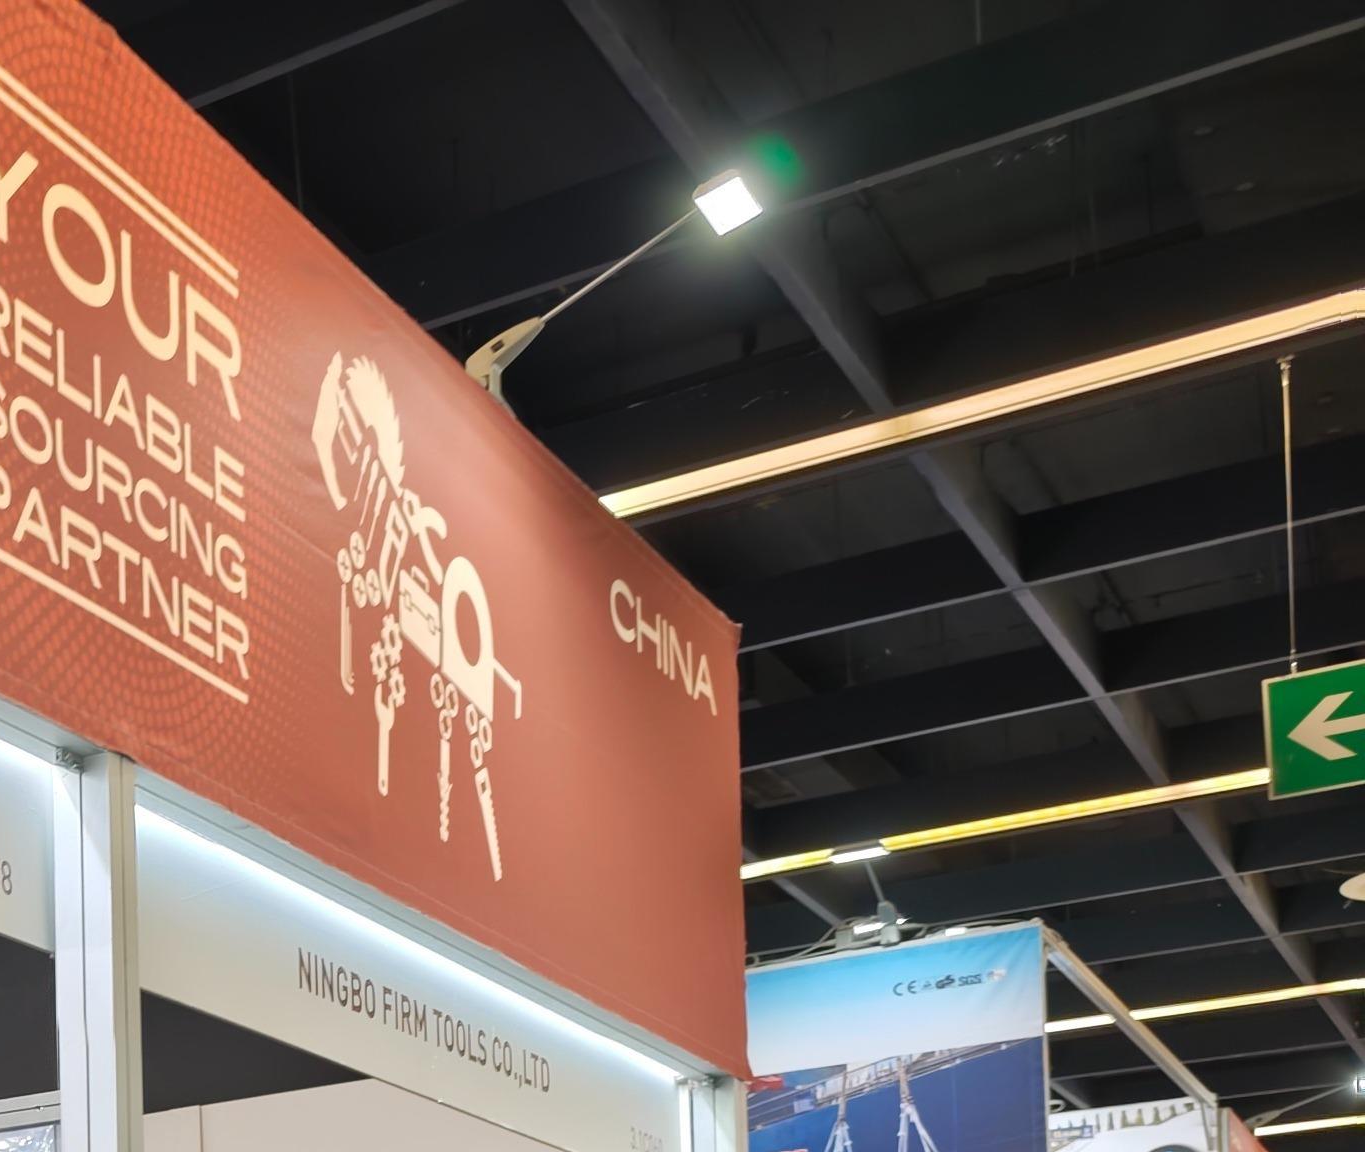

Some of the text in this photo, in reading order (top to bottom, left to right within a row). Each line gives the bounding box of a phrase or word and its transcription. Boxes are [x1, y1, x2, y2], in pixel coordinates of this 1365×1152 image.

[610, 578, 718, 717] CHINA
[297, 947, 550, 1093] NINGBO FIRM TOOLS CO.,LTD
